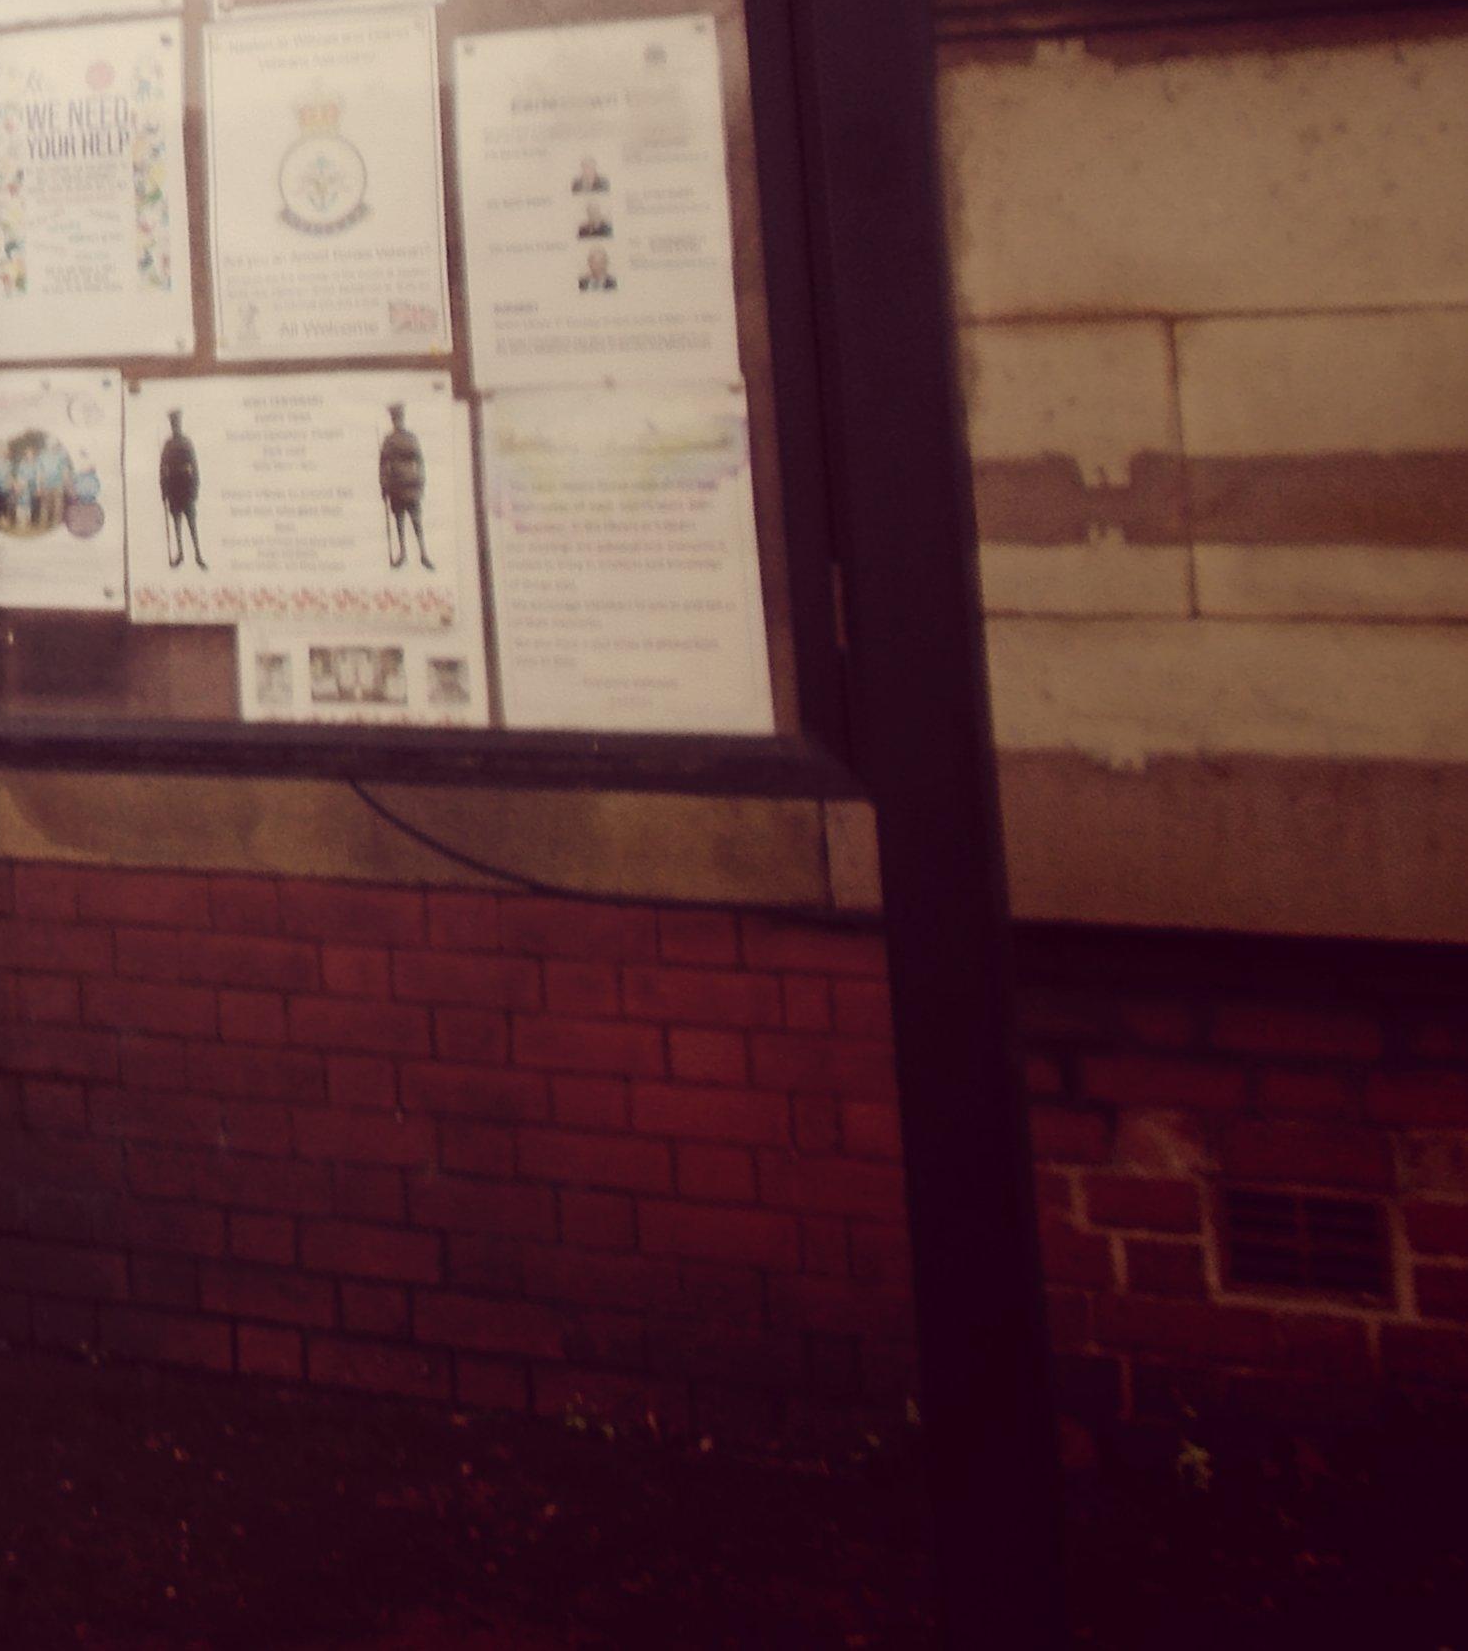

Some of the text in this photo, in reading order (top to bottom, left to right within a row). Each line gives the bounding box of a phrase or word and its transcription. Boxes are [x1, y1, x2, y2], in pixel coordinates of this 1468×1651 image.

[25, 97, 129, 133] WE NEED
[27, 129, 130, 160] YOUR HELP
[303, 319, 380, 337] Welcome
